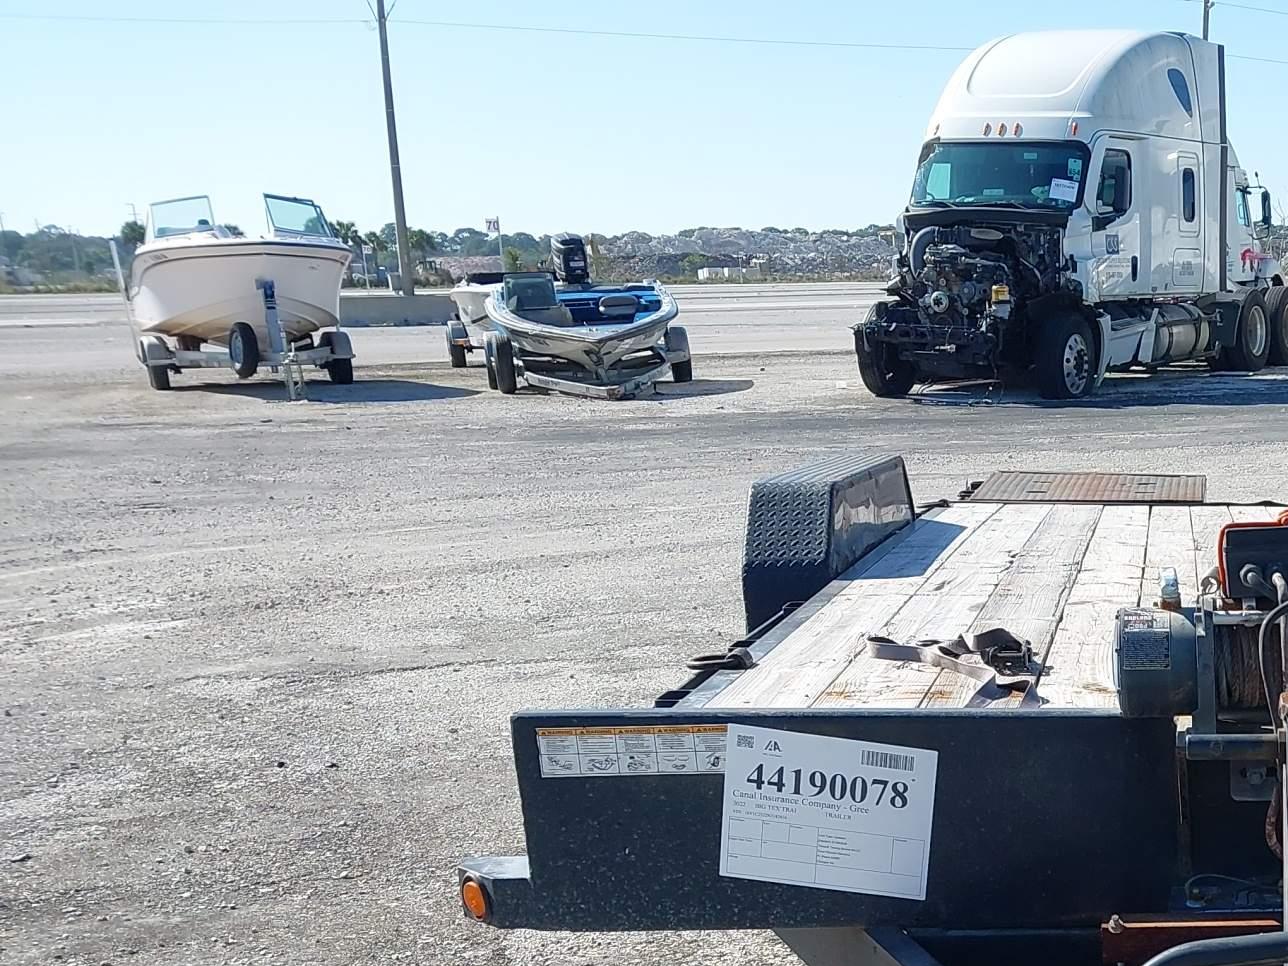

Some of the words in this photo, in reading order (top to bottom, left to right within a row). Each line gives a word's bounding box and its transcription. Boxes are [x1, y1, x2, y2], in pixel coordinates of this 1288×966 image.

[487, 221, 499, 231] 70
[746, 763, 909, 809] 44190078
[732, 789, 756, 799] Canal
[759, 792, 800, 805] Insurance
[801, 798, 842, 812] Company
[849, 804, 870, 814] Gree
